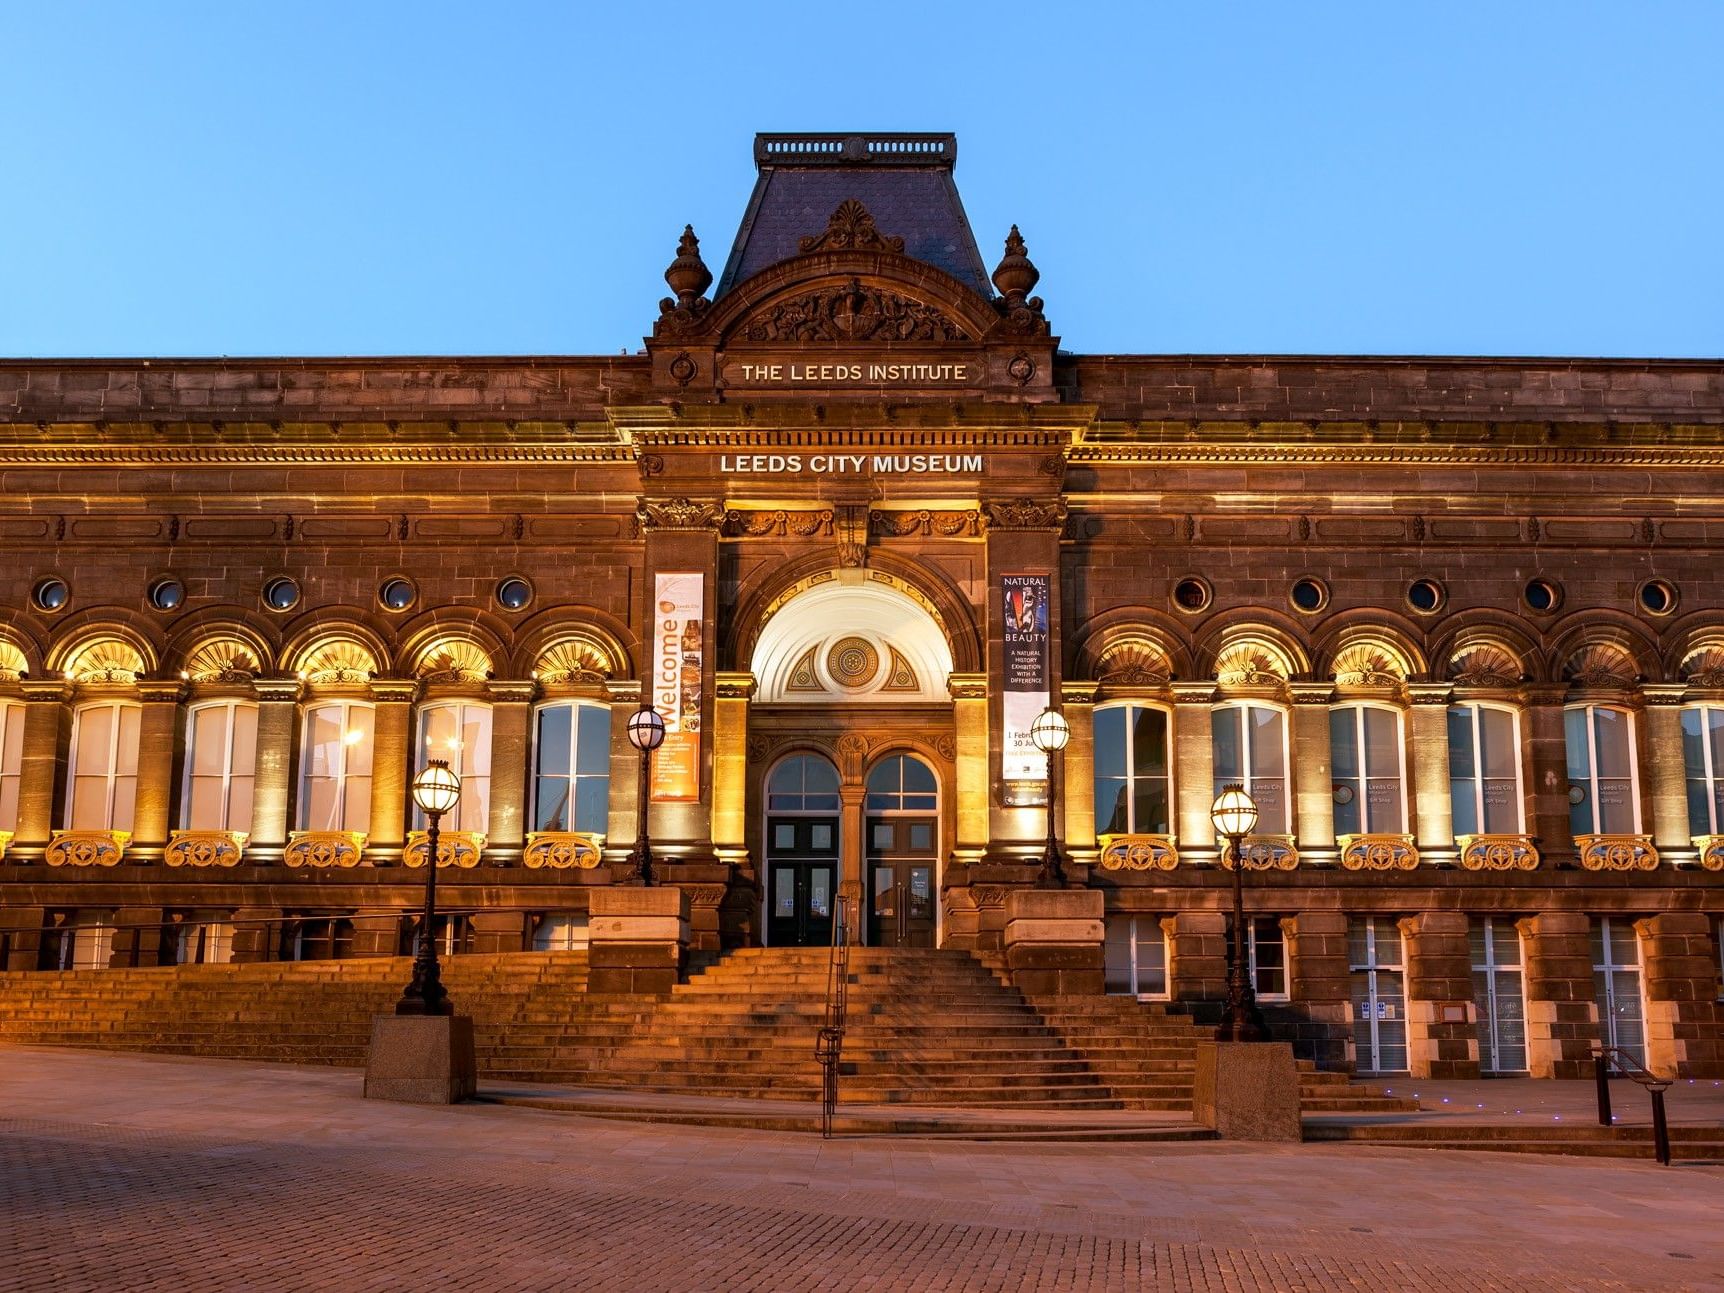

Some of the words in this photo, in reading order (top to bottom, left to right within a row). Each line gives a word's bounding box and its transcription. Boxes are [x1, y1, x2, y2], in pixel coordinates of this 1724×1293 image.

[742, 365, 783, 381] THE
[791, 365, 863, 381] LEEDS
[868, 365, 967, 381] INSTITUTE
[720, 455, 803, 474] LEEDS
[810, 455, 866, 474] CITY
[873, 455, 983, 474] MUSEUM
[1004, 577, 1046, 586] NATURAL
[1005, 633, 1047, 642] BEAUTY
[656, 619, 678, 726] Welcome
[1013, 739, 1023, 747] 30
